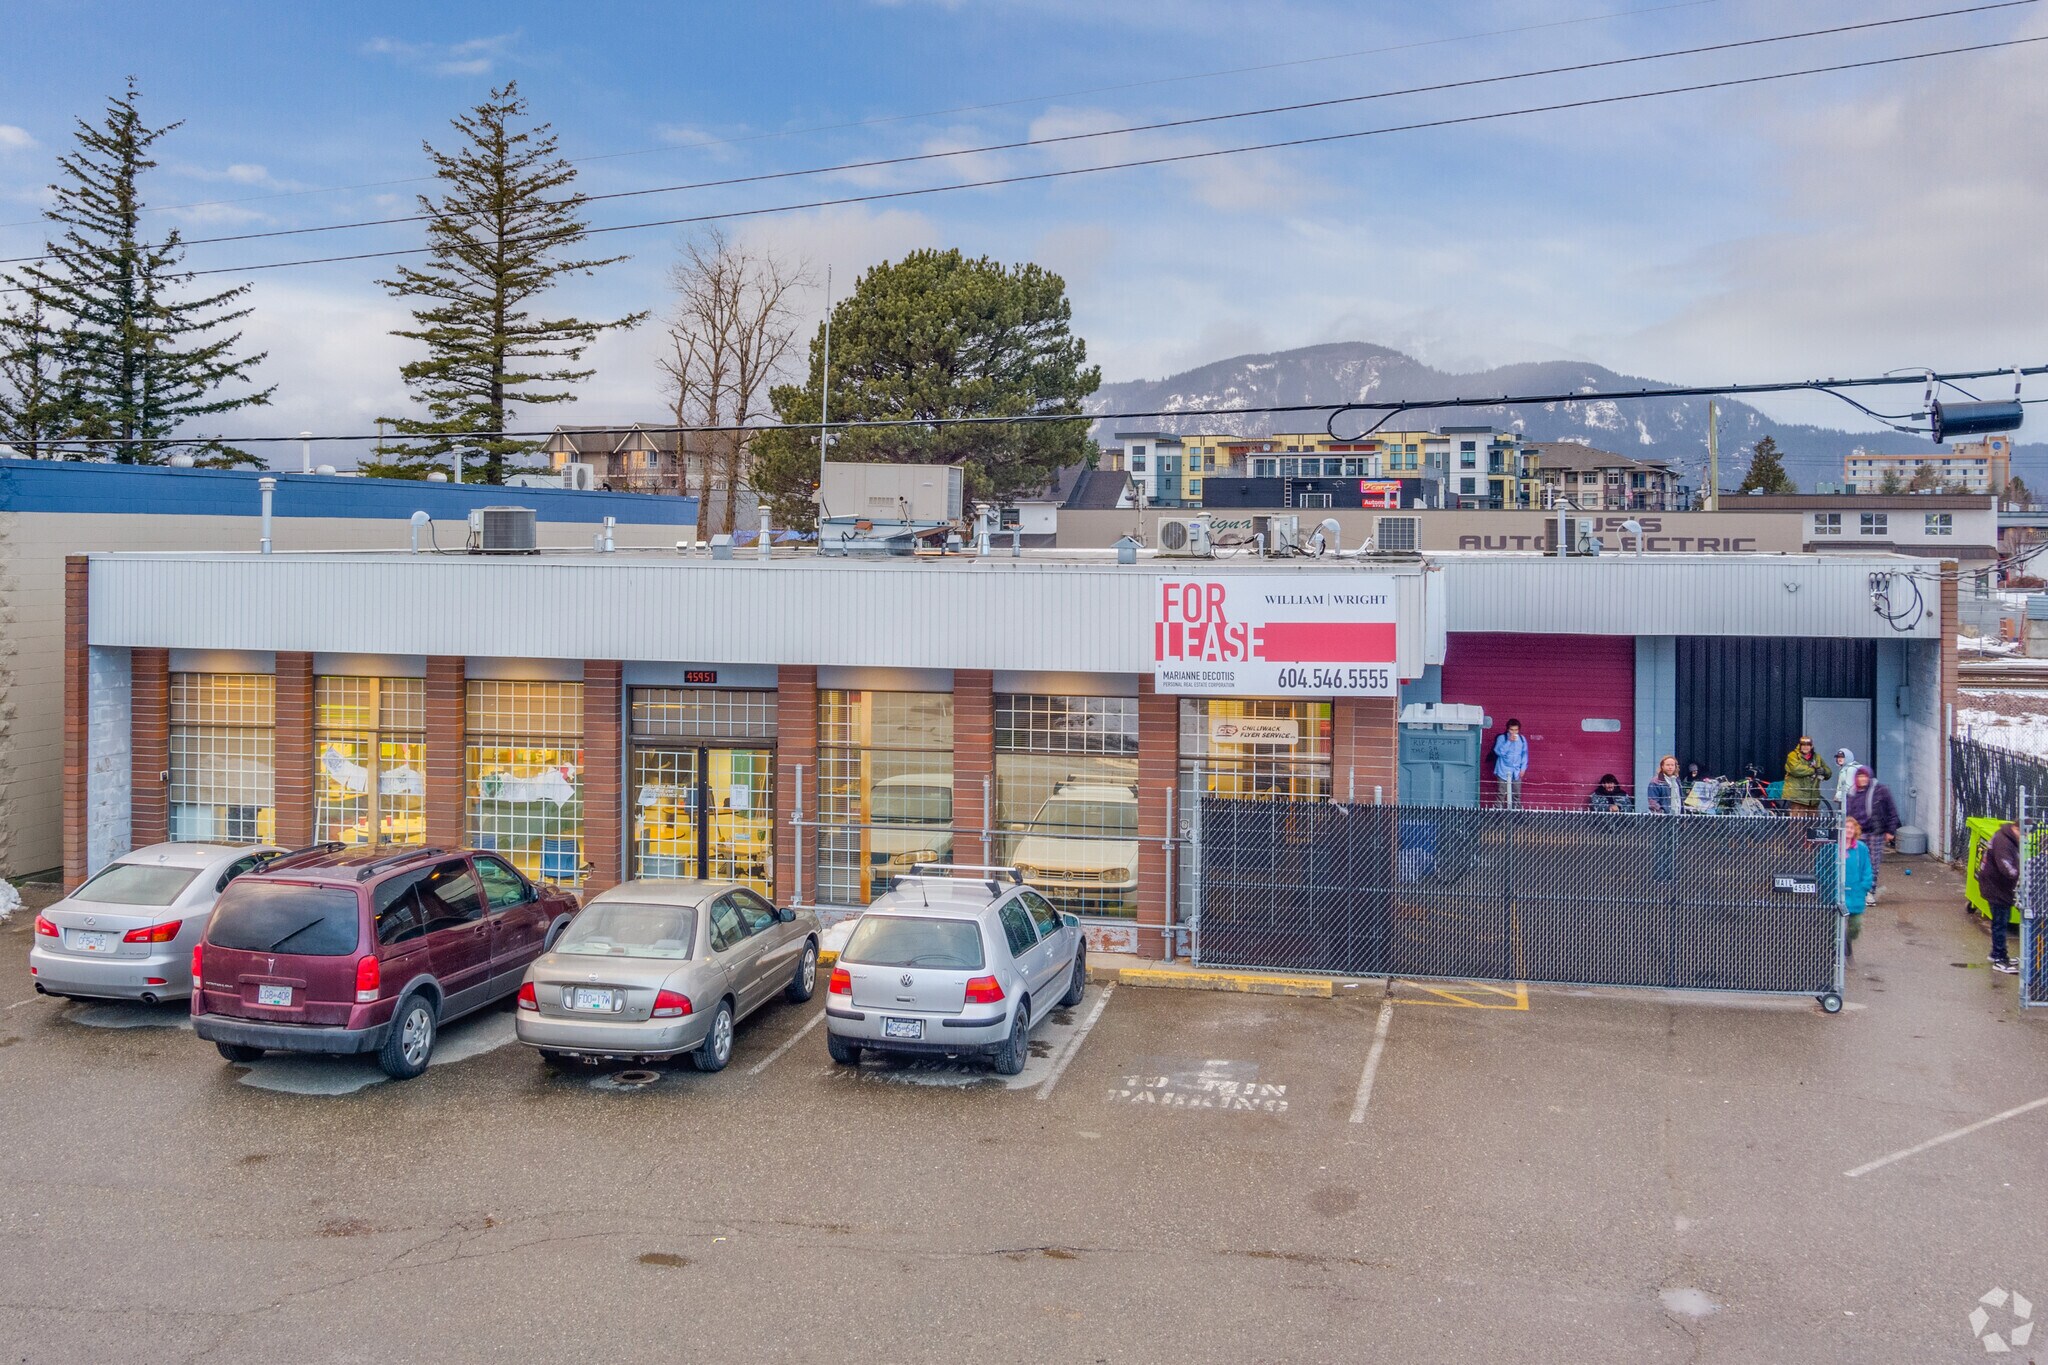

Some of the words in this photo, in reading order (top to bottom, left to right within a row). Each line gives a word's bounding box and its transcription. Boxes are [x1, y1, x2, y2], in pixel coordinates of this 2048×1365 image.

[1597, 536, 1757, 552] LECTRIC
[1163, 583, 1227, 623] FOR
[1265, 595, 1323, 605] WILLIAM
[1333, 595, 1388, 605] WRIGHT
[1163, 622, 1266, 662] LEASE
[687, 672, 715, 682] 45951
[1163, 671, 1200, 681] MARIANNE
[1202, 671, 1235, 681] DECOTIIS
[1278, 669, 1388, 689] 604.546.5555
[1775, 879, 1793, 887] MAIL
[1794, 884, 1815, 893] 45951
